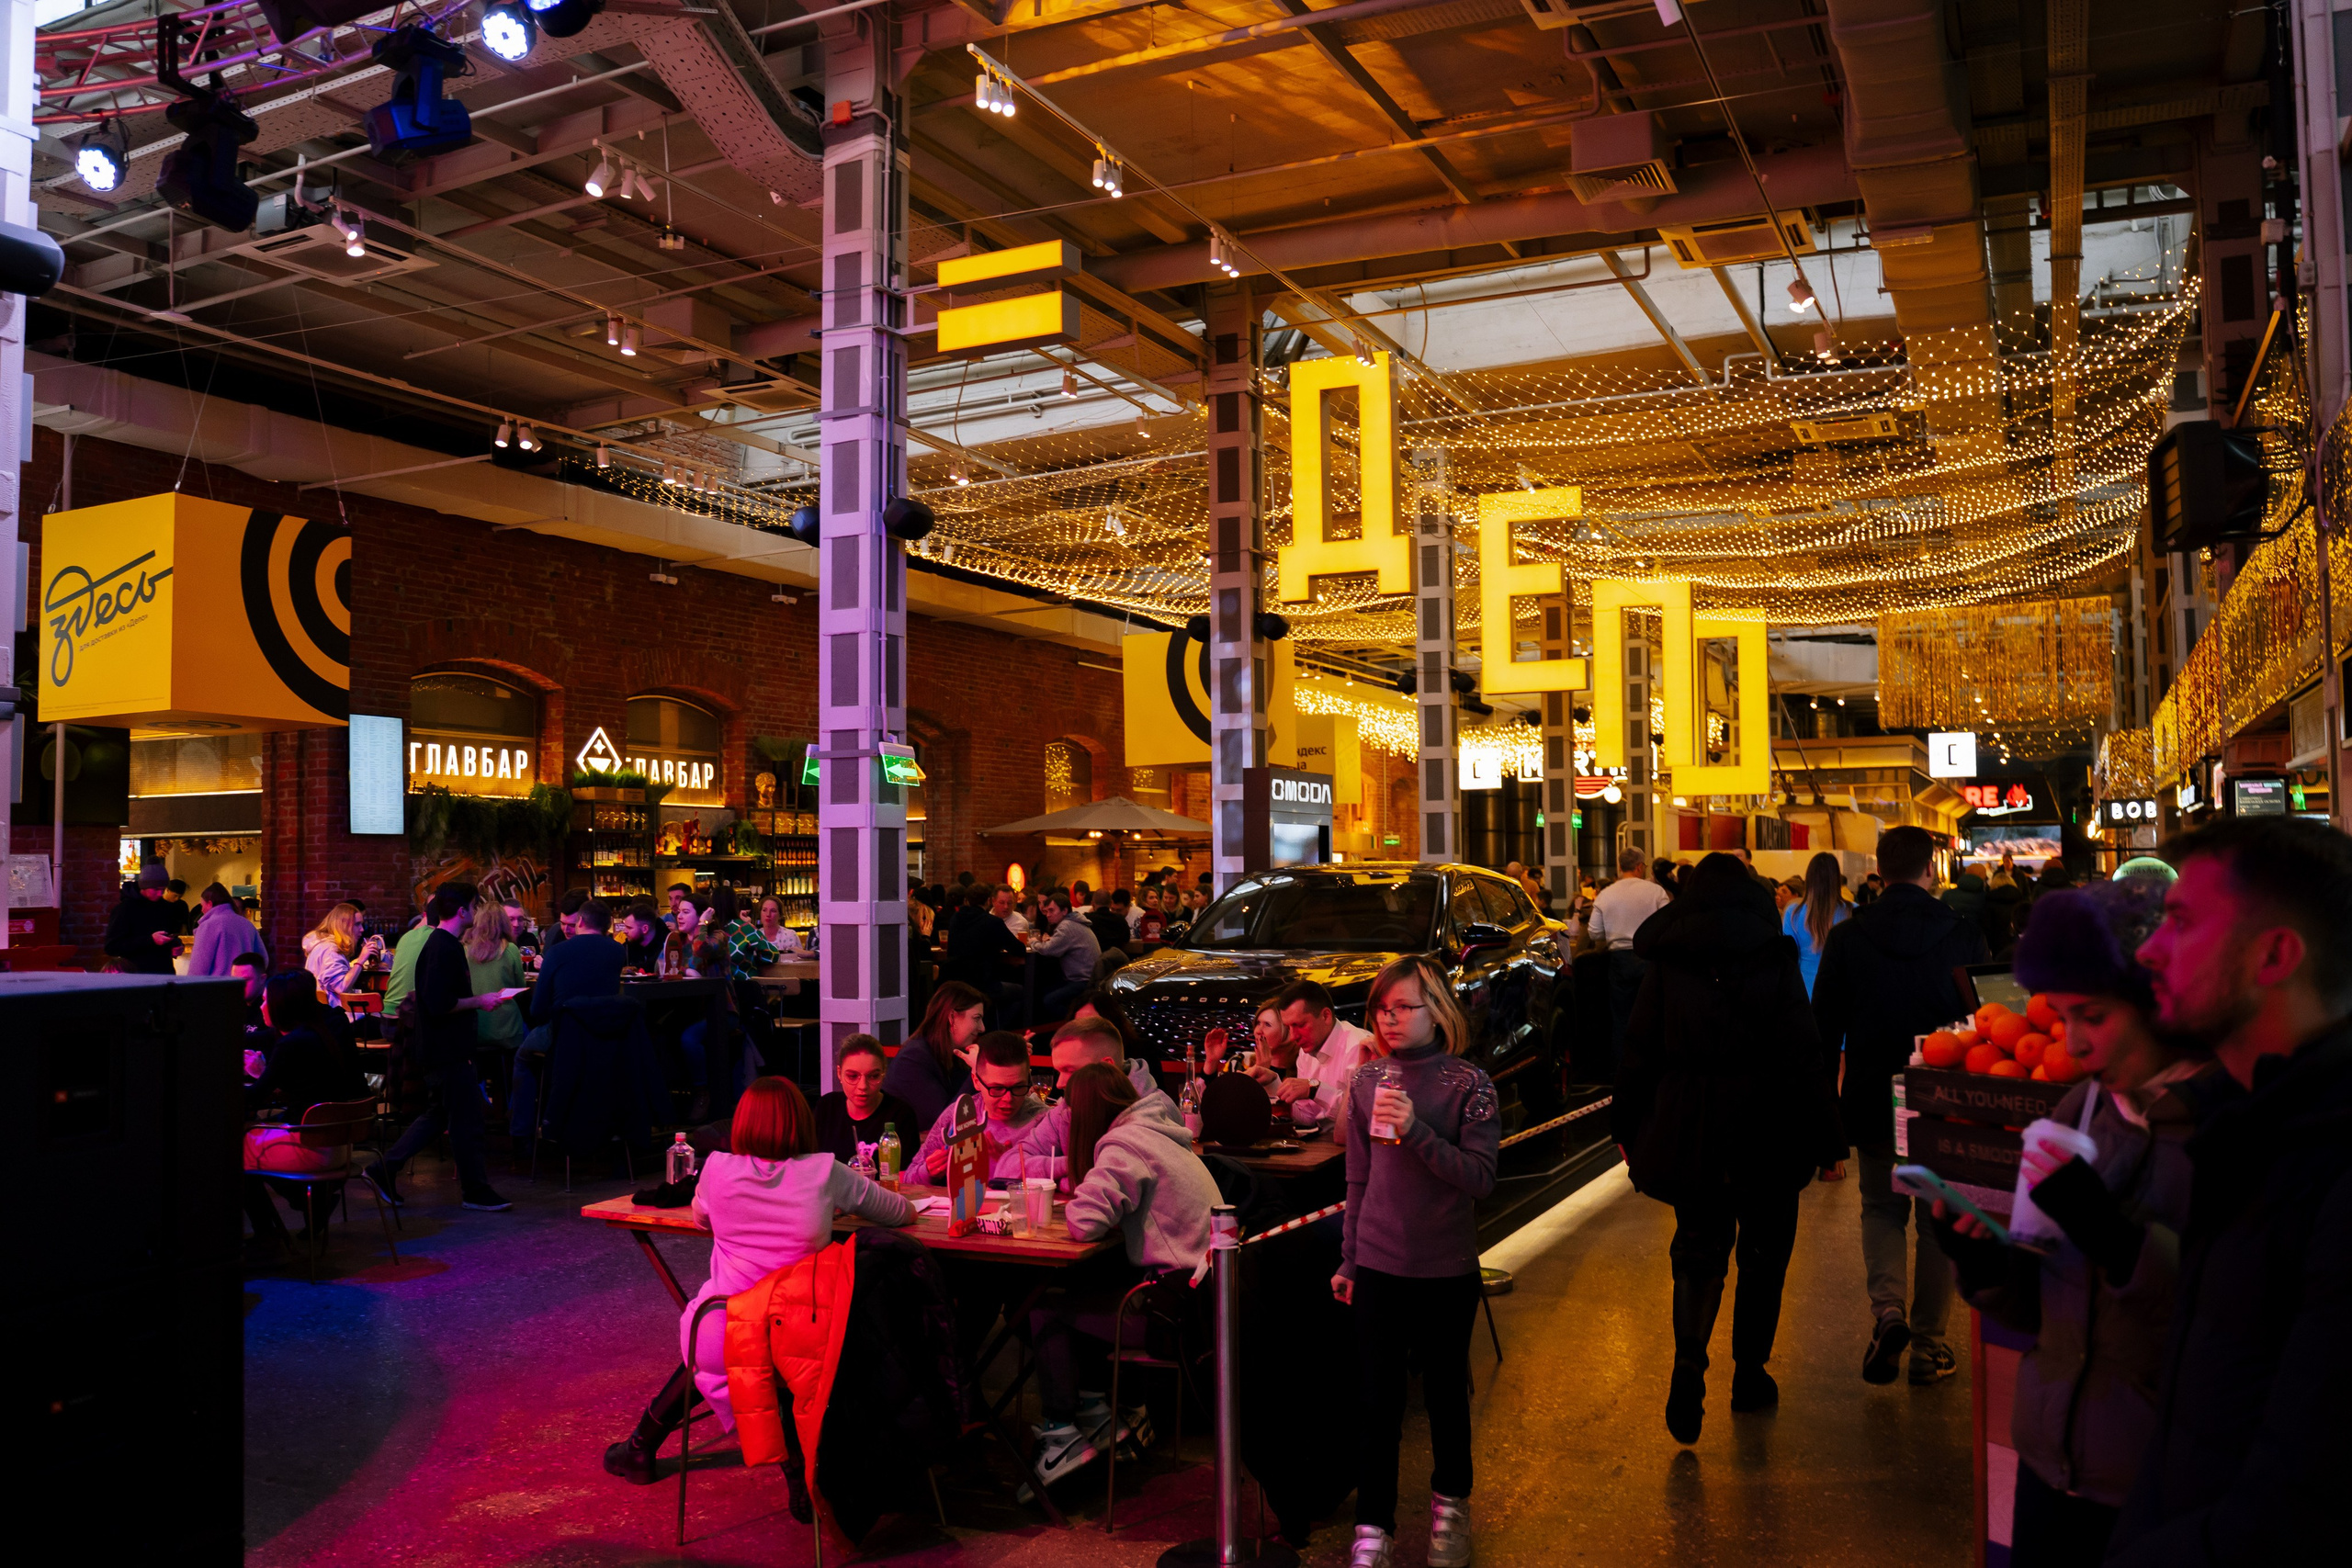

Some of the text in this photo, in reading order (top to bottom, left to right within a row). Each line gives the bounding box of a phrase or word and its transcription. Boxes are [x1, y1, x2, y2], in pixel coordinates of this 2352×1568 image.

[410, 742, 528, 780] ГЛАВБАР
[626, 756, 714, 789] ЛАВБАР
[1272, 778, 1332, 805] OMODA
[1958, 785, 1999, 807] RE
[1933, 1086, 1962, 1104] ALL
[2001, 1095, 2047, 1115] NEED
